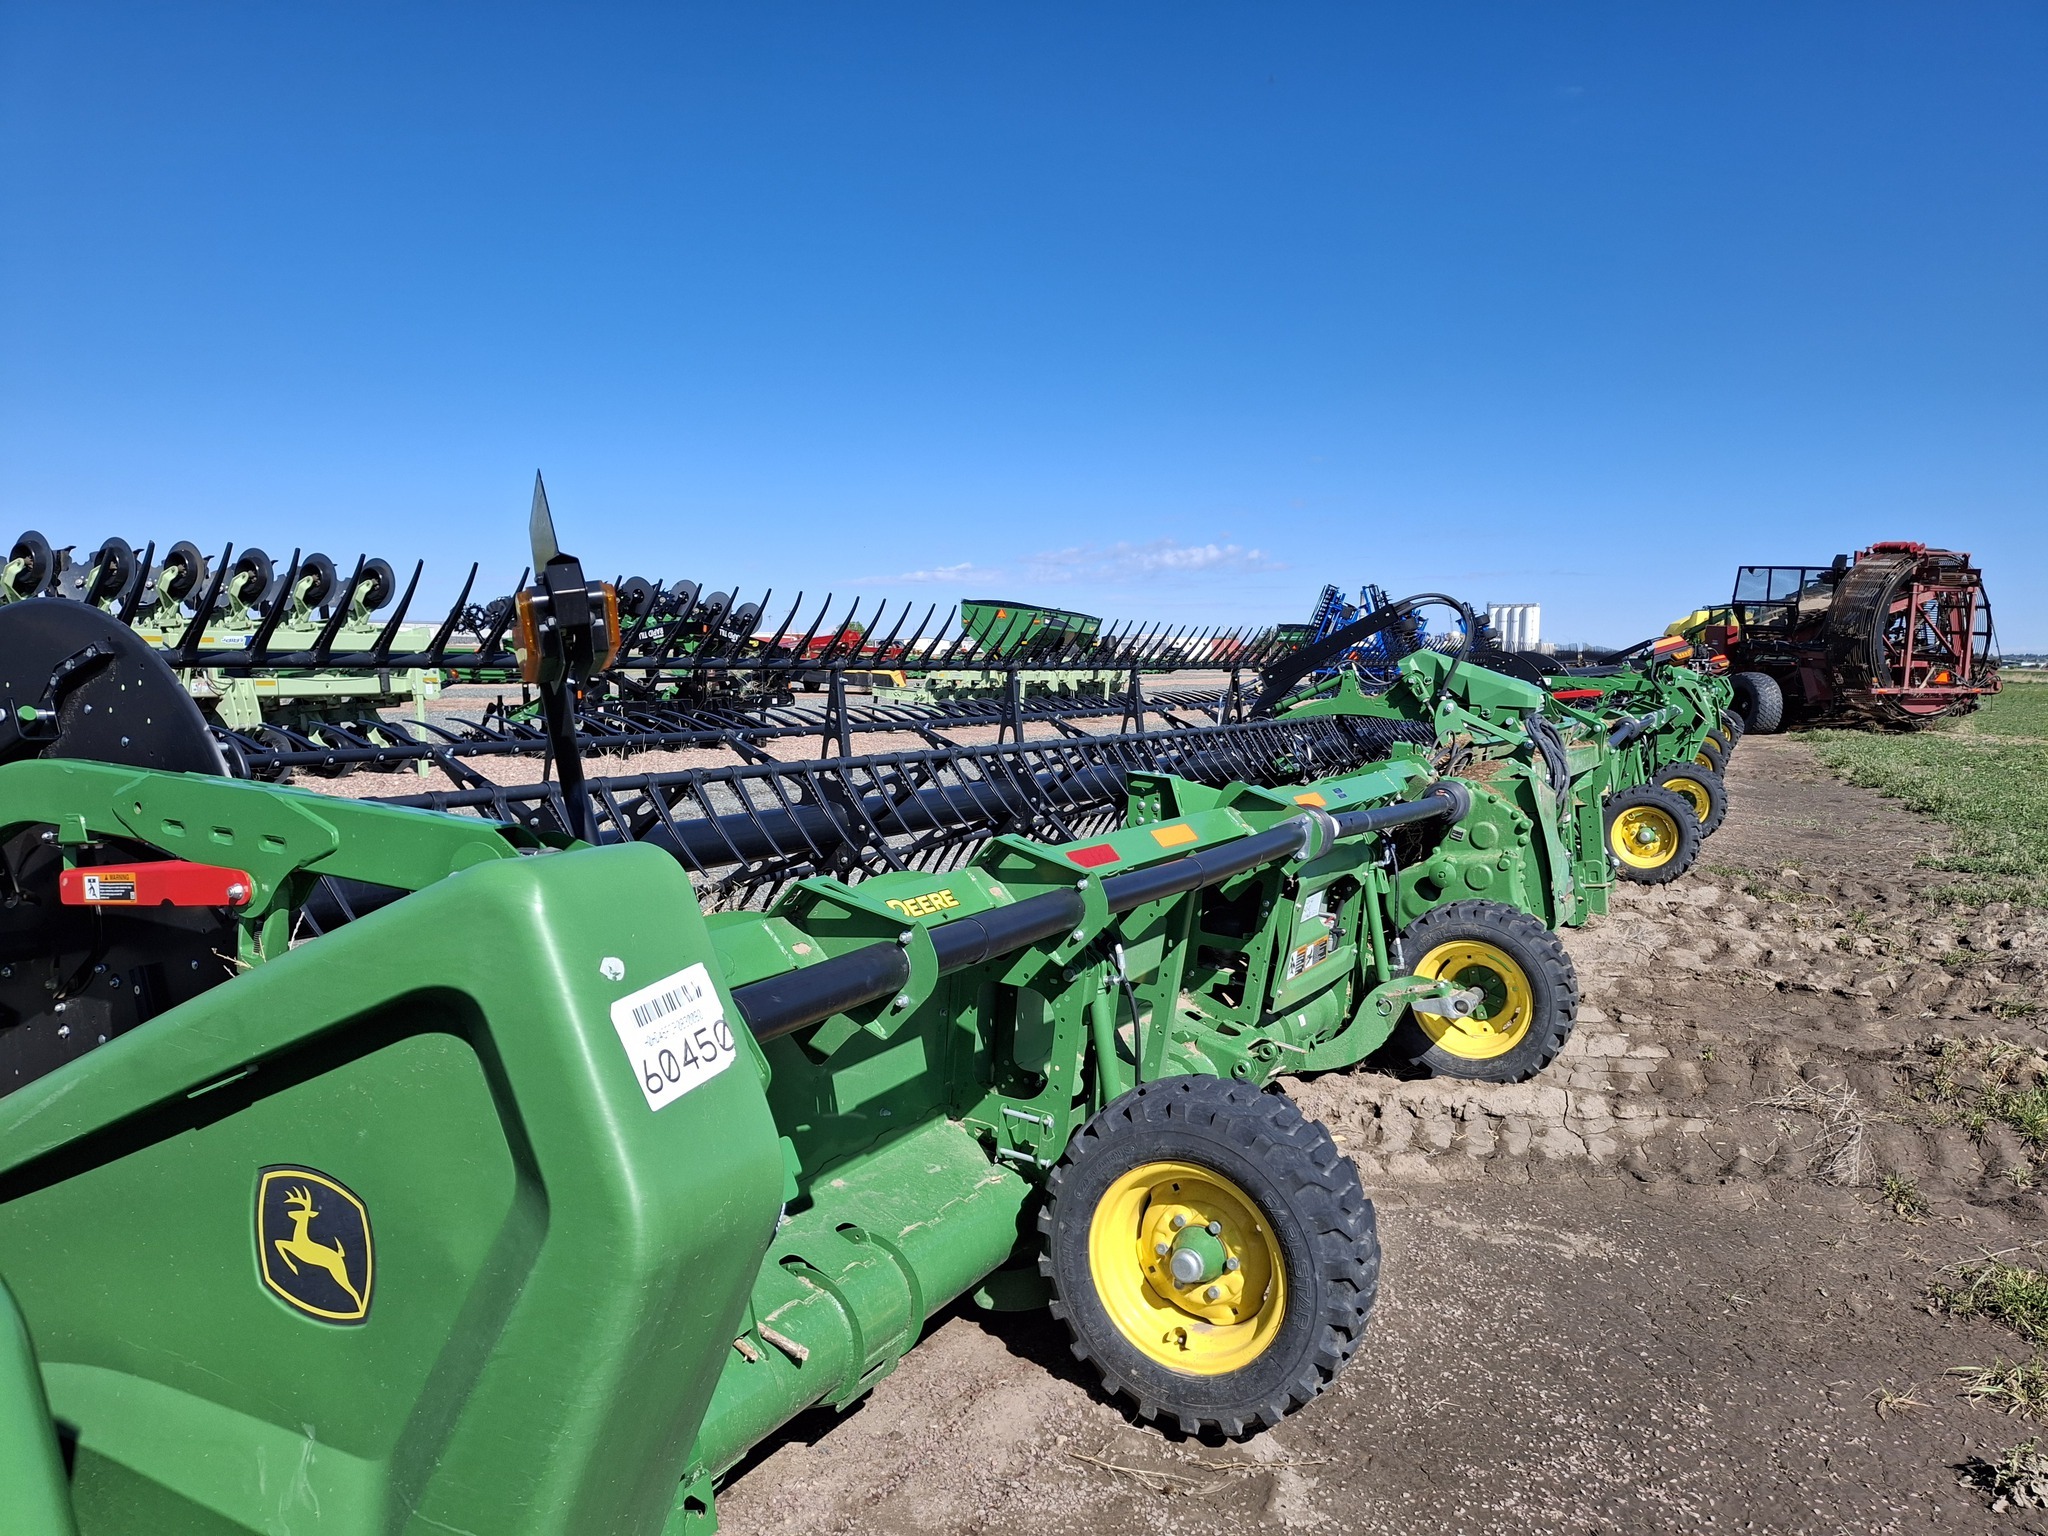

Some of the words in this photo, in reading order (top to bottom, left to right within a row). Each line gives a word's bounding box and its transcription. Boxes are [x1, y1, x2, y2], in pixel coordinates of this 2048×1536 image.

[648, 627, 664, 638] RAPID
[885, 888, 960, 918] DEERE
[643, 1019, 735, 1095] 60450
[1261, 1190, 1313, 1331] CARLSTAR
